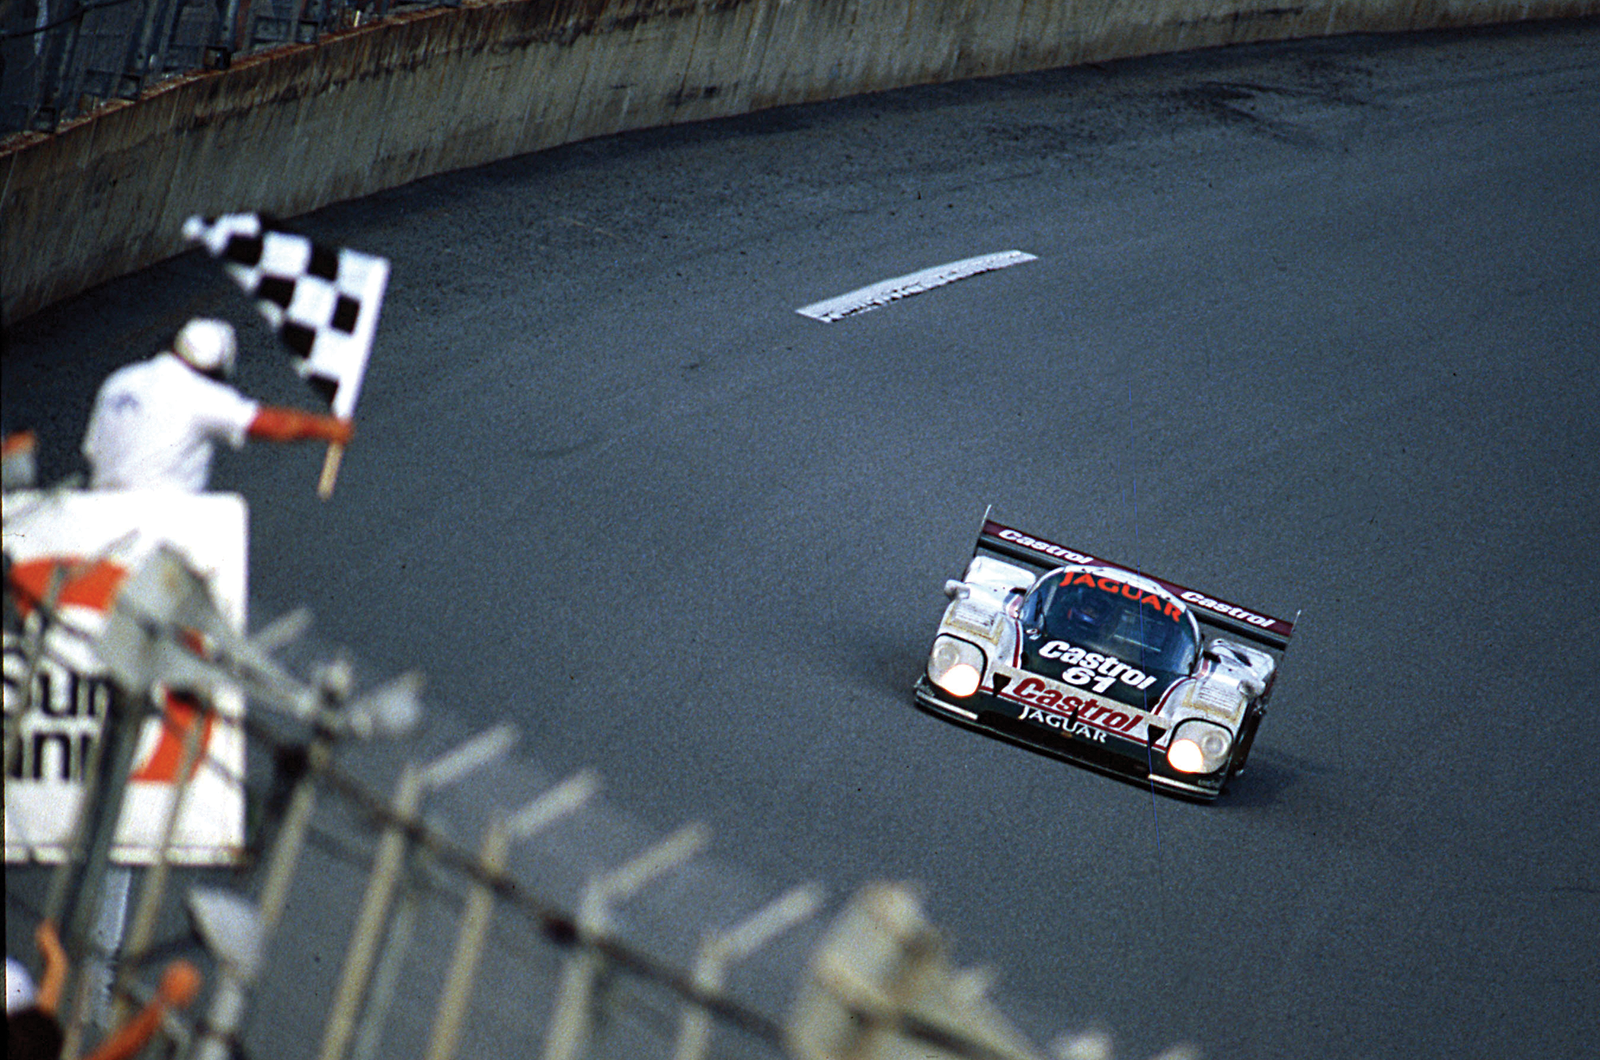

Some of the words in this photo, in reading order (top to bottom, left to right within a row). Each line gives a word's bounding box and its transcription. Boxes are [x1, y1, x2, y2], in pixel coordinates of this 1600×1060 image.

[999, 529, 1094, 564] Castrol
[1059, 571, 1183, 622] JAGUAR
[1180, 591, 1276, 627] Castrol
[1038, 640, 1158, 690] Castrol
[1062, 666, 1117, 693] 61
[1013, 677, 1144, 732] Castrol
[1018, 705, 1108, 743] JAGUAR
